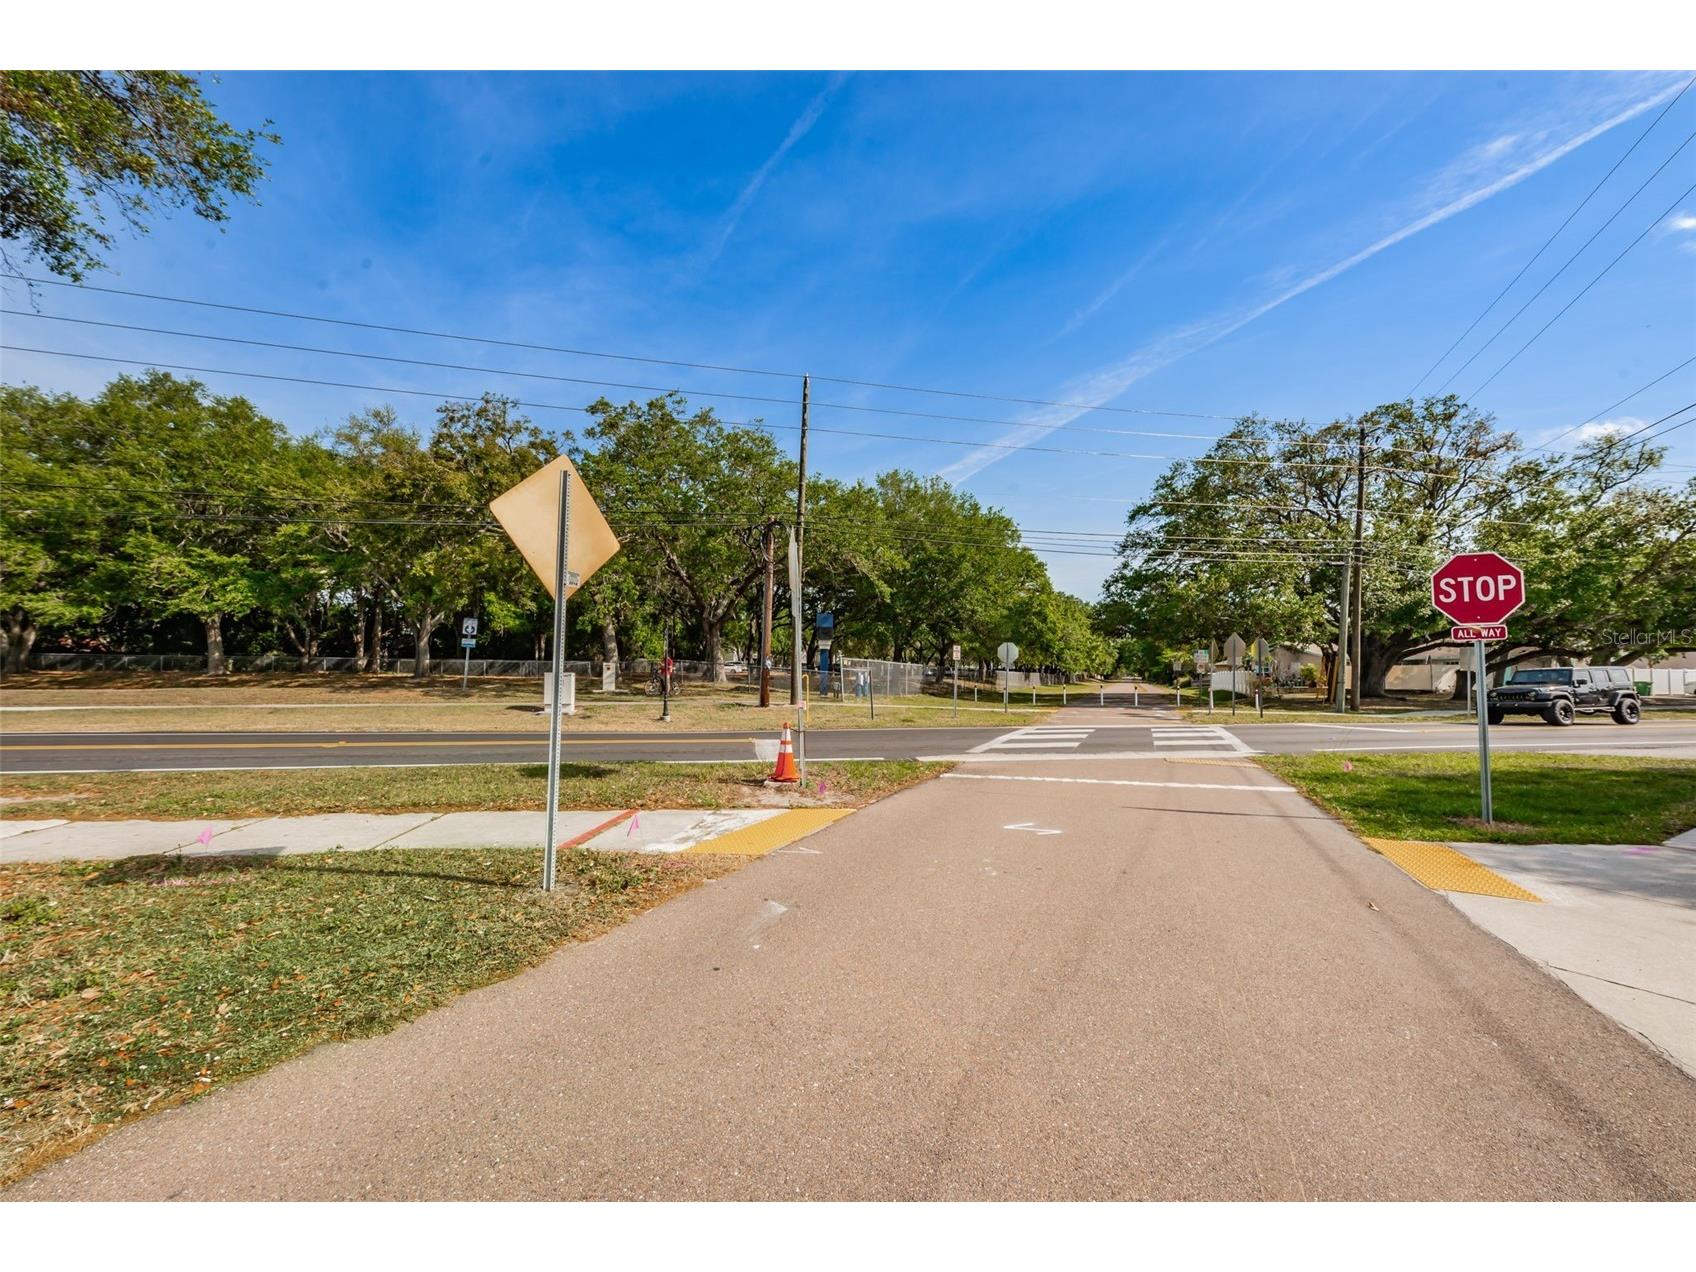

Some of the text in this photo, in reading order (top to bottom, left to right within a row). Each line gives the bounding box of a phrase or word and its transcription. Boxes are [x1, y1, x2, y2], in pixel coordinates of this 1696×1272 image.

[1438, 574, 1517, 603] STOP
[1457, 628, 1501, 638] ALL WAY
